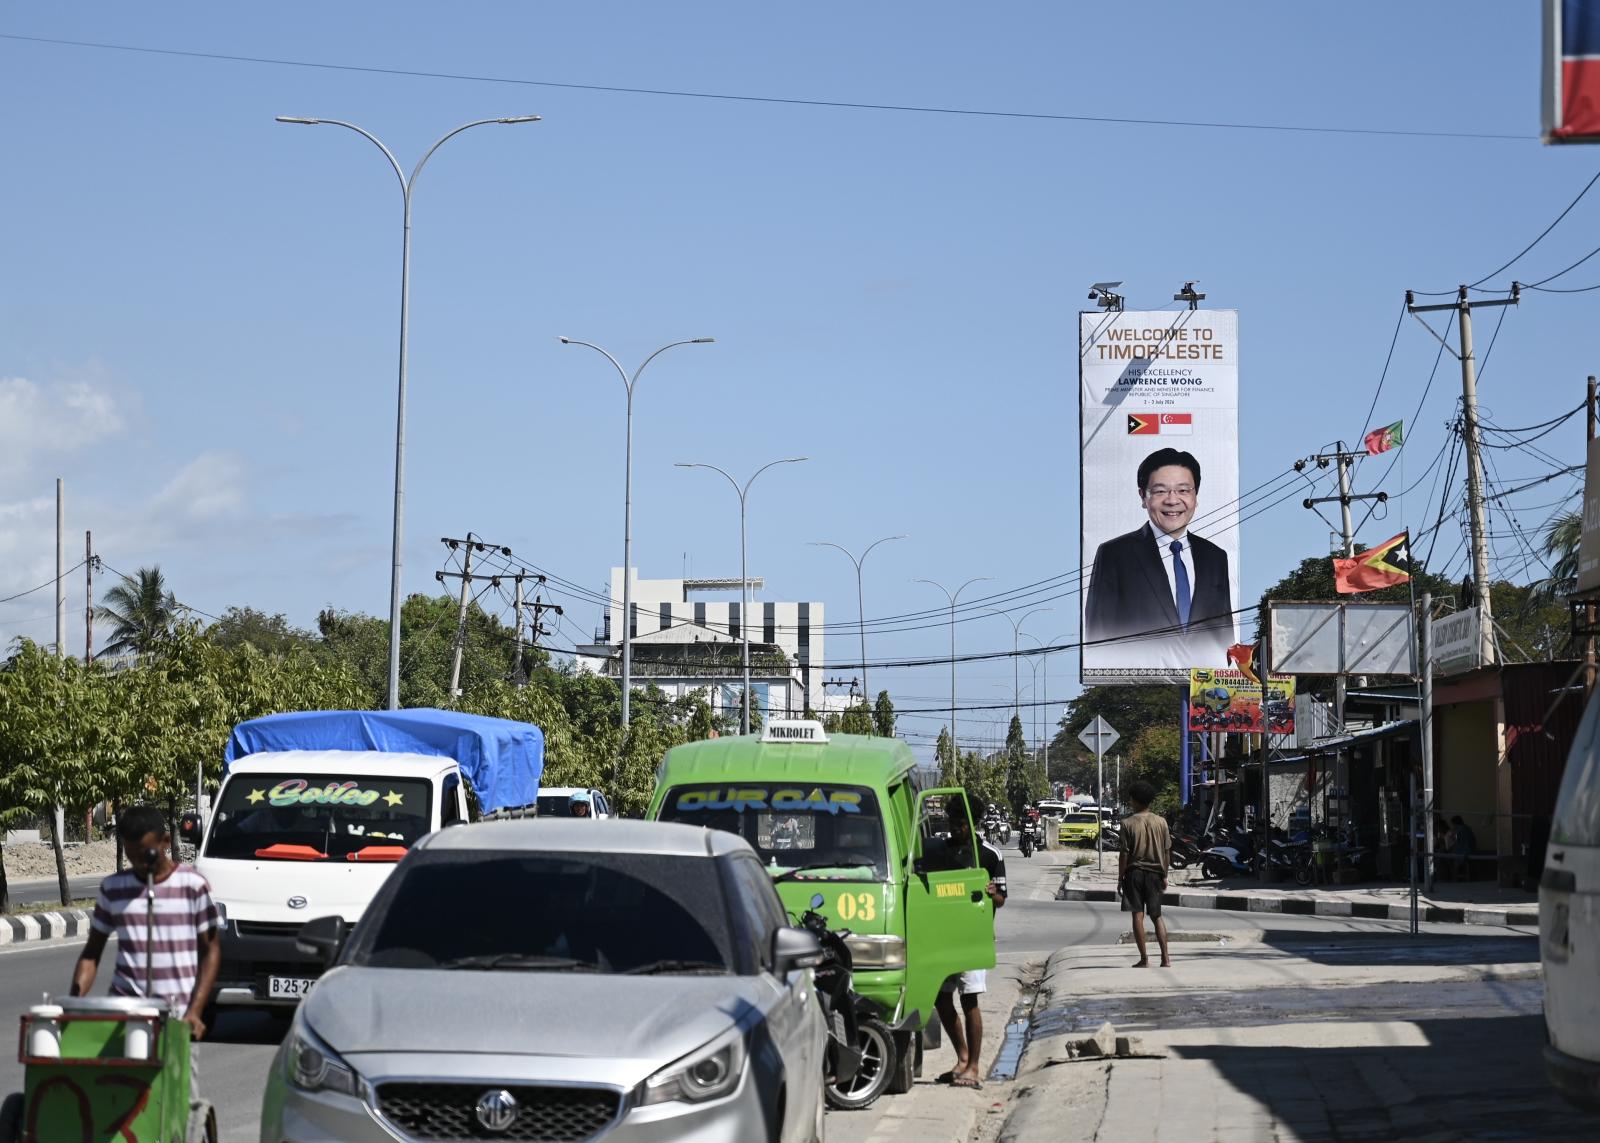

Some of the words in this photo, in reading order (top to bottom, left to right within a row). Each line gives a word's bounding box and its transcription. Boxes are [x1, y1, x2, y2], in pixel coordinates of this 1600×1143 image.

[1107, 328, 1188, 341] WELCOME
[1193, 328, 1213, 341] TO
[1096, 344, 1223, 360] TIMOR-LESTE
[1118, 377, 1168, 386] LAWRENCE
[1170, 377, 1203, 386] WONG
[769, 726, 815, 740] MIKROLET
[676, 787, 768, 814] OUR
[770, 787, 862, 816] CAR
[936, 882, 966, 898] MICROLET
[837, 892, 876, 922] 03
